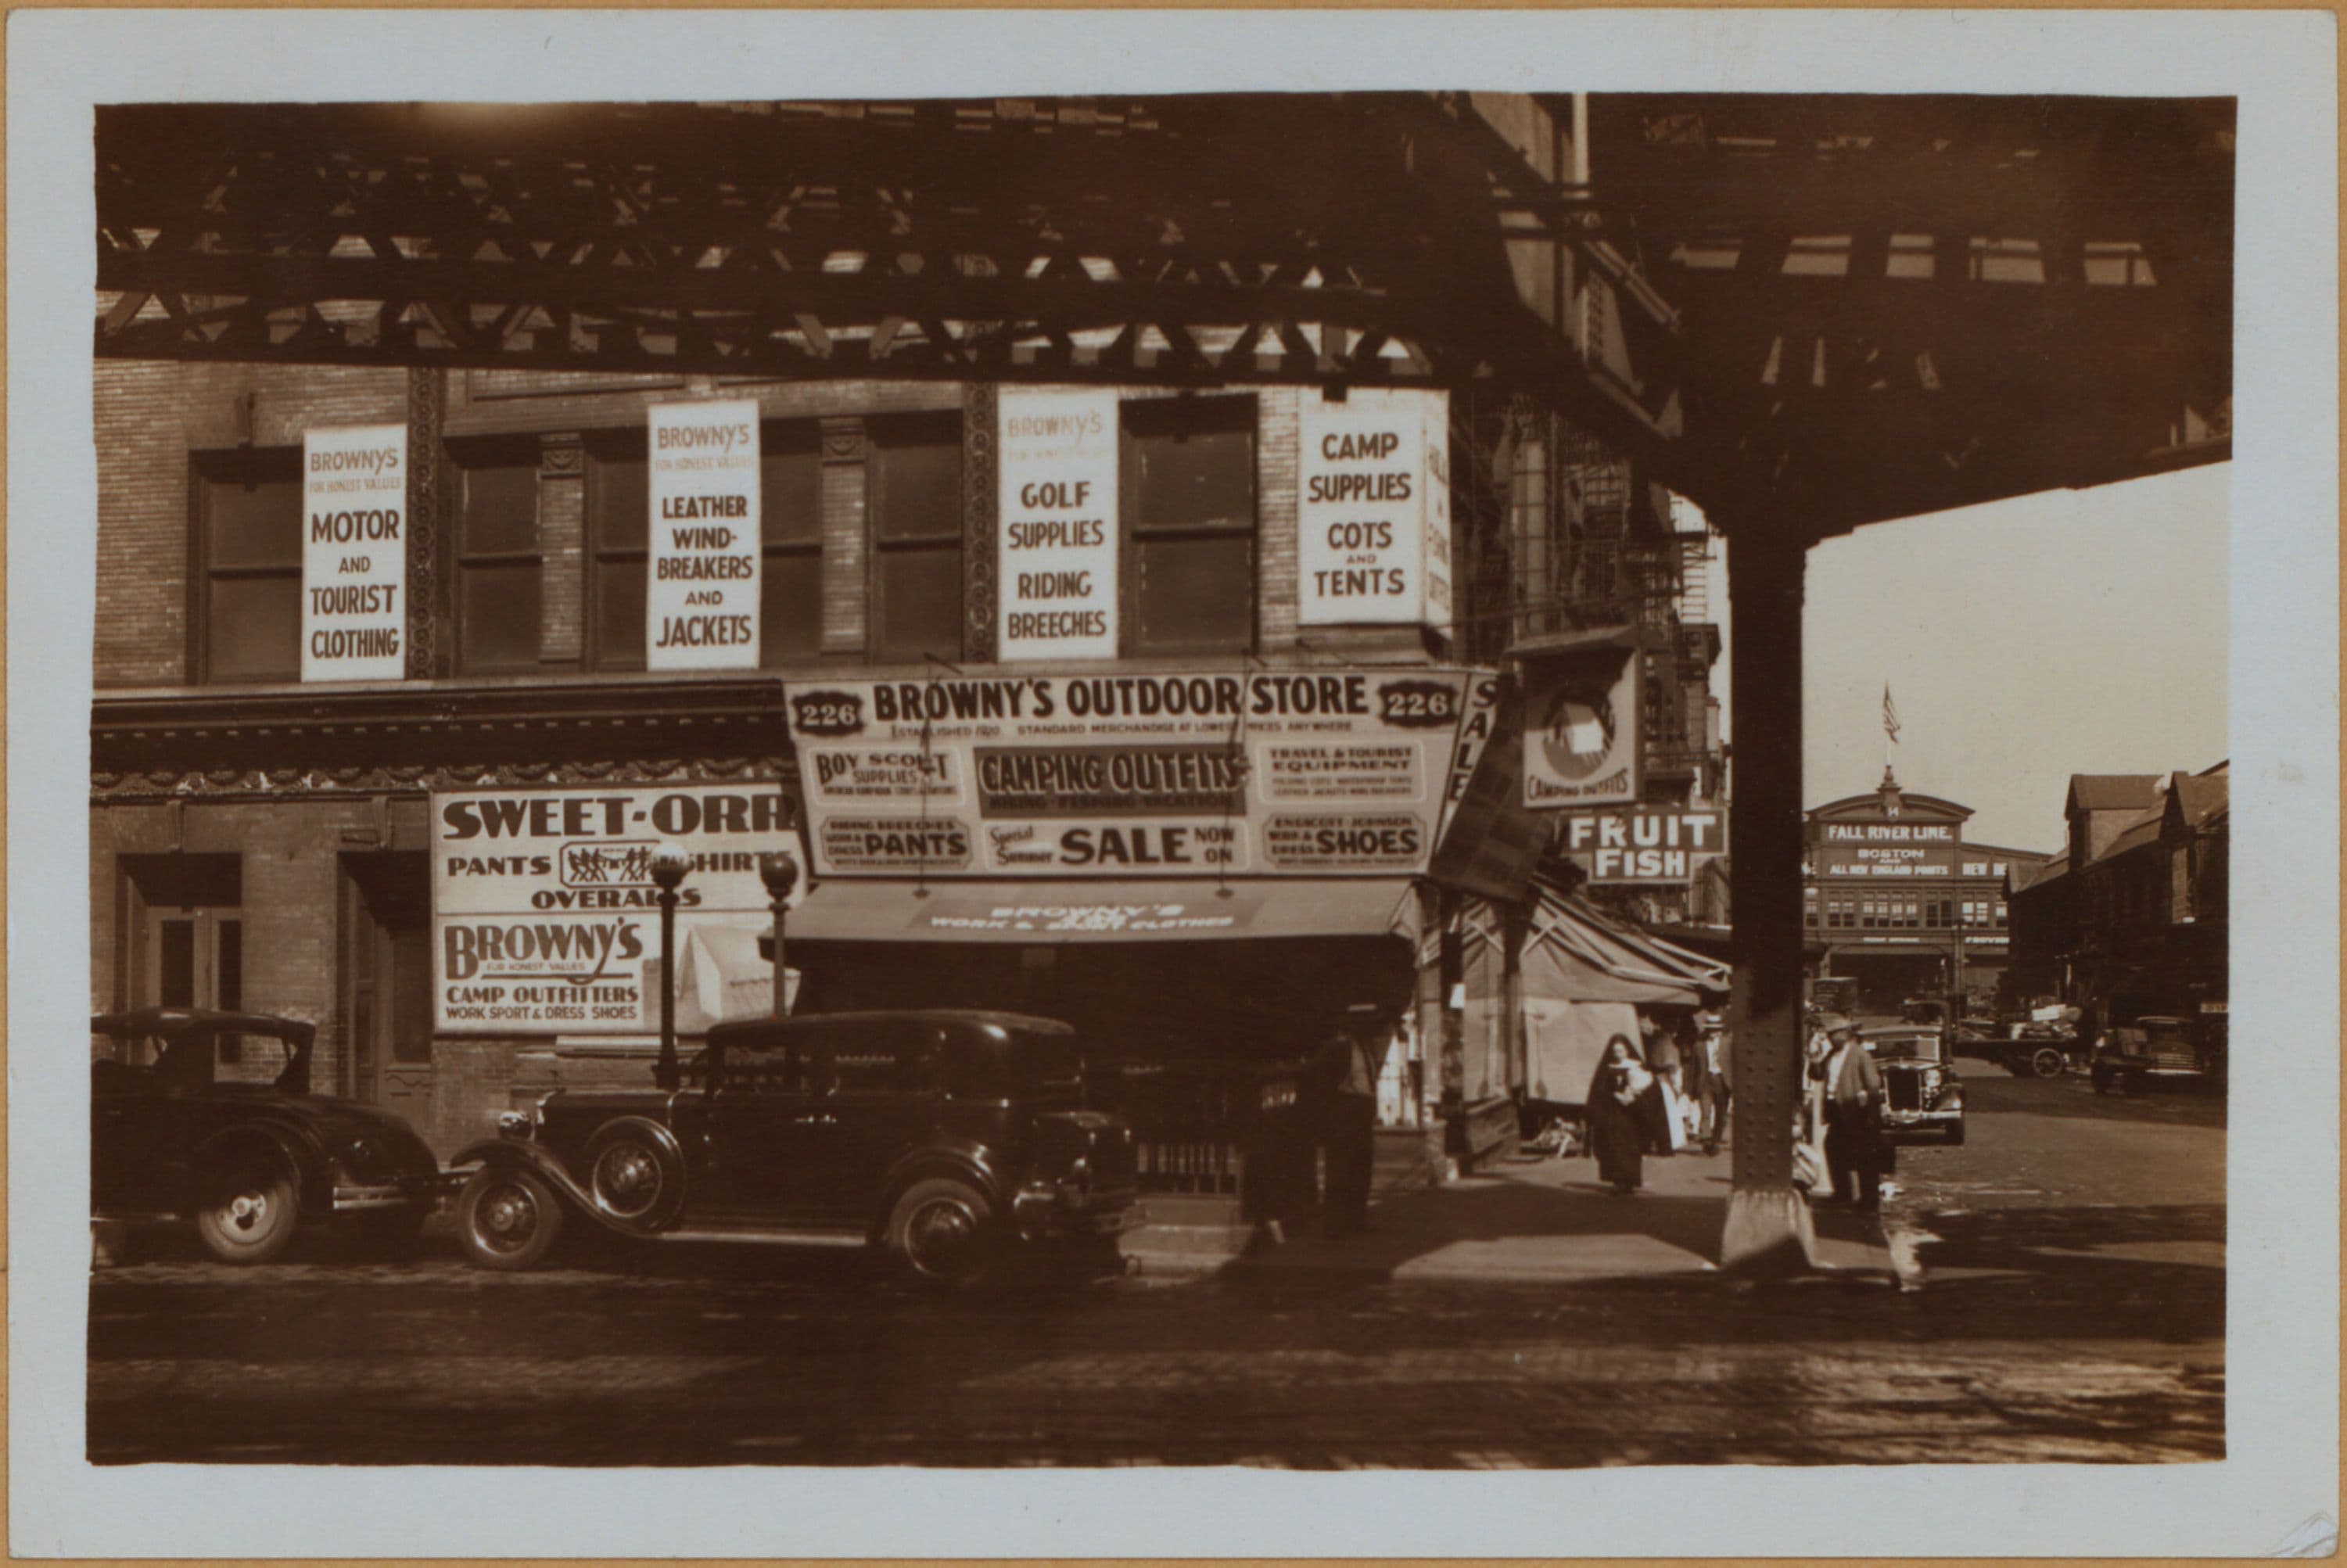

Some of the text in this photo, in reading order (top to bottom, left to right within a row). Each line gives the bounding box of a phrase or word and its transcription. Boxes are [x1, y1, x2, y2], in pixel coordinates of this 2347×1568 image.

[1322, 432, 1398, 461] CAMP
[1021, 481, 1090, 510] GOLF
[1308, 472, 1411, 503] SUPPLIES
[662, 496, 748, 519] LEATHER
[312, 509, 400, 543] MOTOR
[1008, 520, 1104, 549] SUPPLIES
[1328, 522, 1392, 550] COTS
[672, 527, 737, 550] WIND-
[339, 556, 371, 574] AND
[657, 555, 753, 580] BREAKERS
[1346, 554, 1376, 565] AND
[1018, 571, 1092, 599] RIDING
[1314, 569, 1405, 597] TENTS
[310, 584, 397, 615] TOURIST
[685, 590, 723, 606] AND
[656, 615, 752, 647] JACKETS
[1008, 611, 1106, 639] BREECHES
[311, 628, 400, 659] CLOTHING
[801, 676, 1448, 727] 226 BROWNY'S OUTDOOR STORE 226
[890, 724, 972, 740] ESTALISHED
[1017, 724, 1086, 736] STANDARD
[1270, 748, 1329, 759] TRAVEL
[1349, 746, 1412, 758] TOURIST
[816, 752, 859, 785] BOY
[852, 769, 918, 784] SUPPLIES
[979, 752, 1245, 795] CAMPING OUTFITS
[1272, 759, 1410, 773] EQUIPMENT
[443, 793, 798, 840] SWEET-ORR
[864, 832, 968, 856] PANTS
[1193, 826, 1235, 843] NOW
[1315, 828, 1419, 855] SHOES
[1569, 815, 1717, 849] FRUIT
[1828, 825, 1865, 840] FALL
[1868, 825, 1911, 840] RIVER
[1059, 827, 1192, 866] SALE
[1204, 848, 1233, 864] ON
[1857, 849, 1925, 859] BOSTON
[448, 856, 552, 877] PANTS
[684, 851, 791, 873] SHIRT
[1595, 849, 1686, 877] FISH
[1829, 864, 1848, 875] ALL
[530, 888, 702, 910] OVERALS
[931, 917, 1008, 929] WORK
[444, 916, 644, 982] BROWNY'S
[508, 962, 544, 971] HONEST
[548, 961, 586, 971] VALUES
[445, 985, 640, 1004] CAMP OUTFITTERS
[445, 1006, 637, 1020] WORK SPORT & DRESS SHOES
